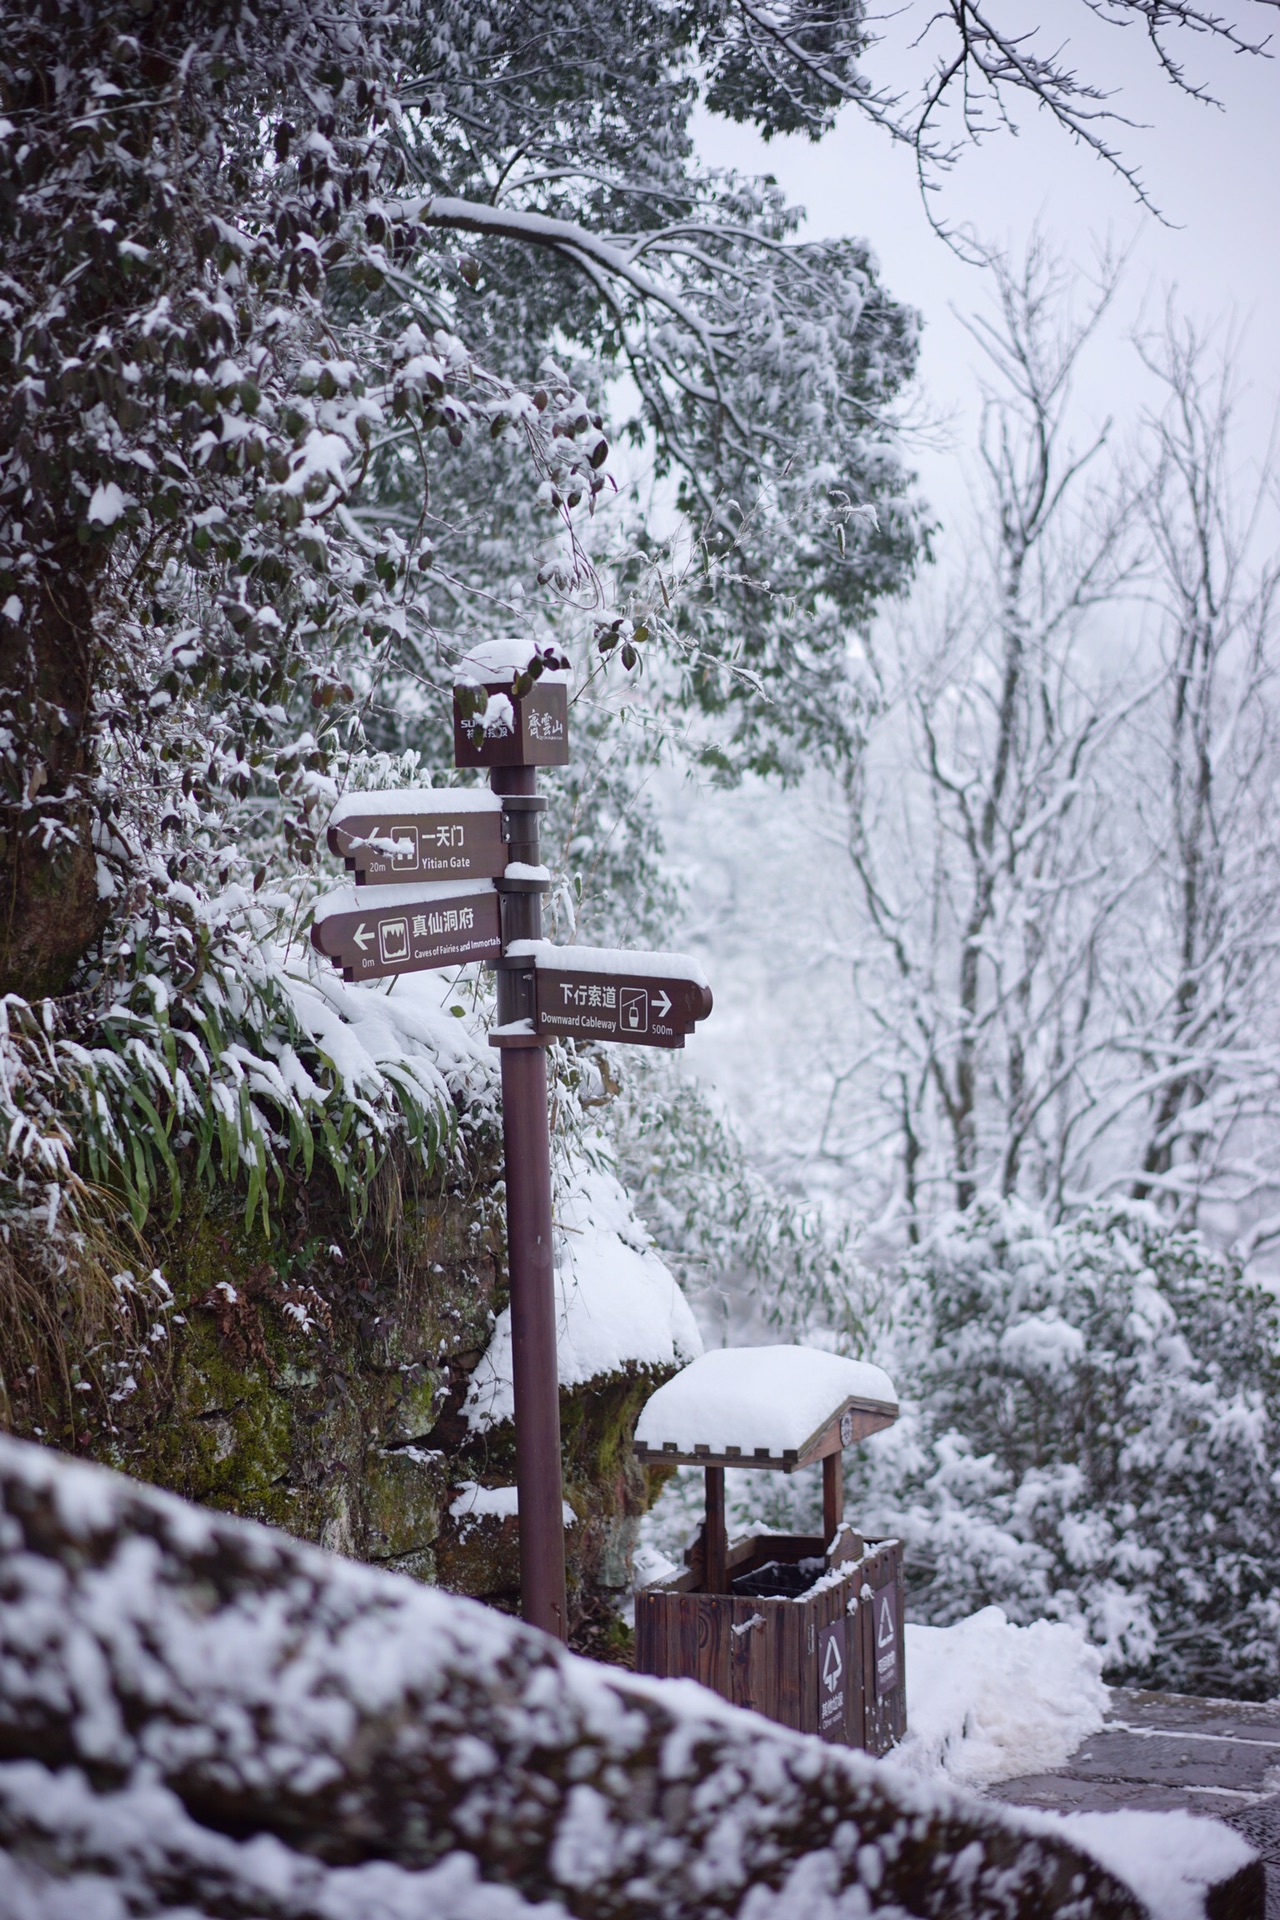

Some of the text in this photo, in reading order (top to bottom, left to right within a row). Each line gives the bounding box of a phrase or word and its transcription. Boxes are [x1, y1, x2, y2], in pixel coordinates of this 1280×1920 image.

[421, 825, 464, 847] 一天门
[369, 862, 386, 873] 20m
[421, 856, 471, 869] Yitian Gate
[412, 907, 474, 937] 真仙洞府
[414, 936, 502, 959] Caves of Fairies and Immortals
[361, 958, 375, 968] 0m
[559, 983, 617, 1008] 下行索道
[541, 1012, 617, 1032] Downward Cableway
[652, 1024, 673, 1035] 500m
